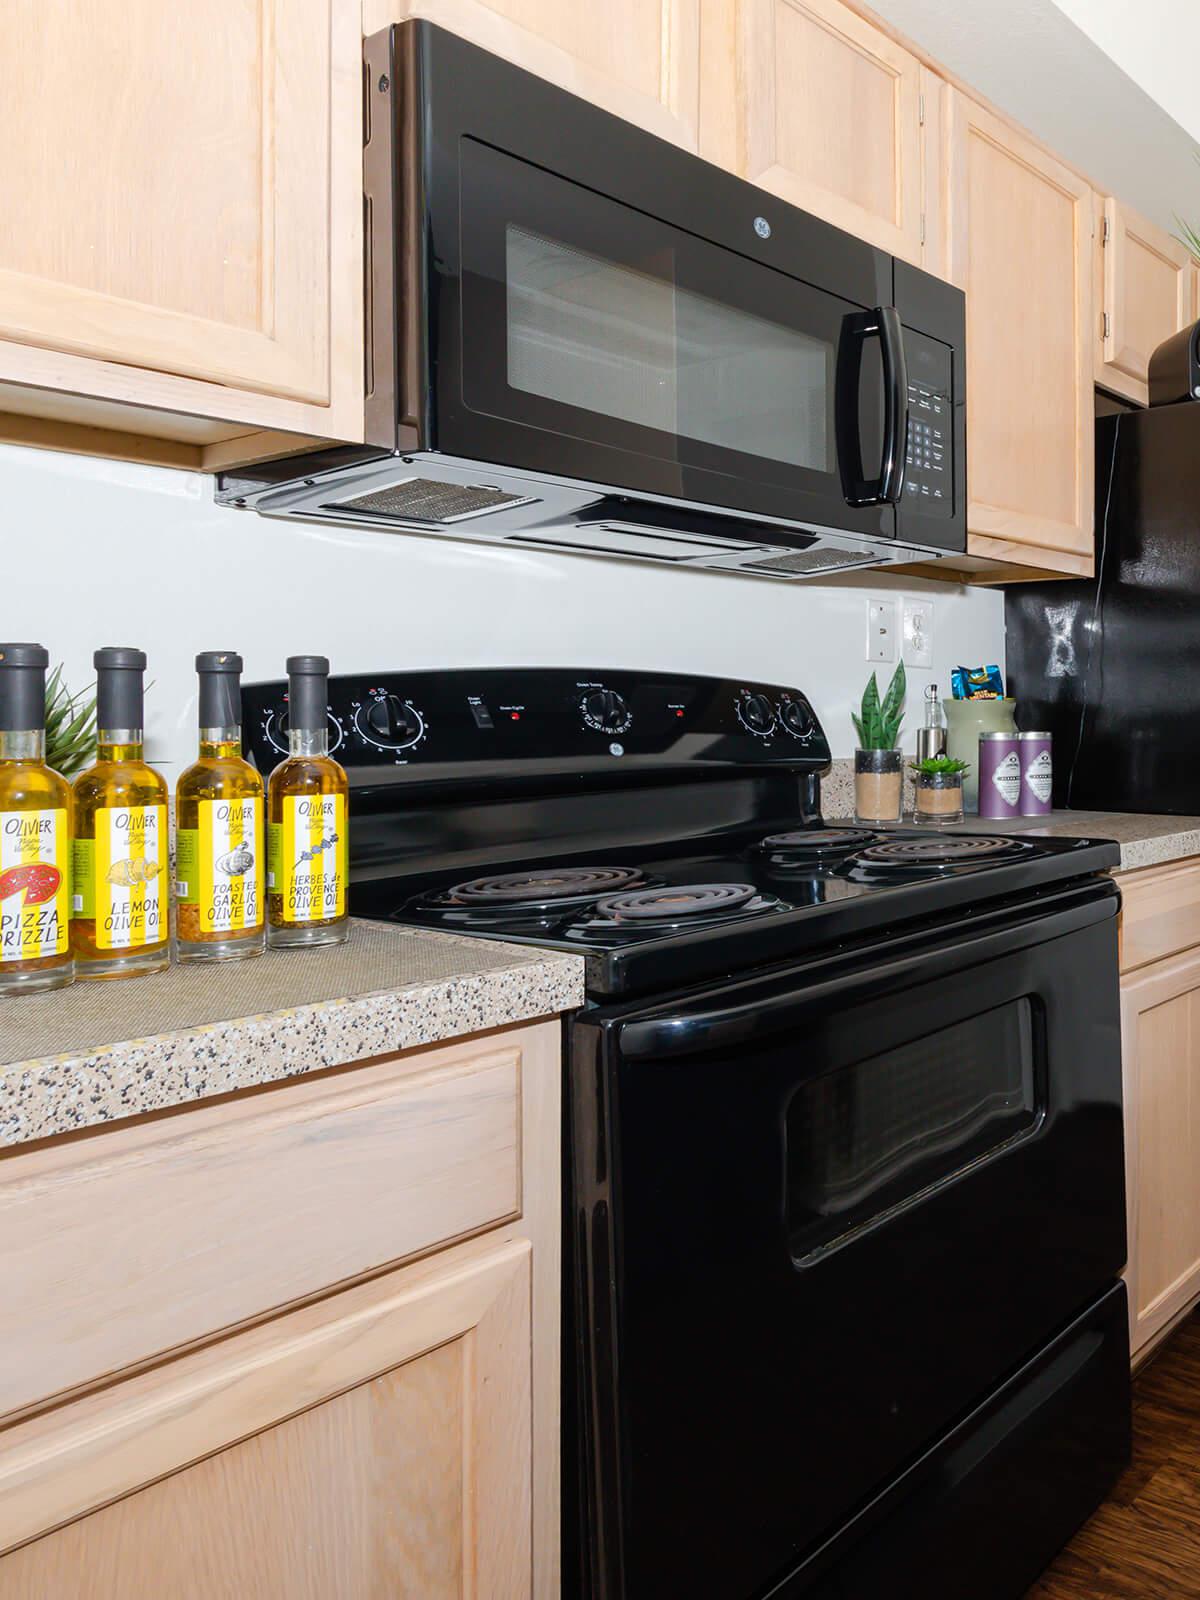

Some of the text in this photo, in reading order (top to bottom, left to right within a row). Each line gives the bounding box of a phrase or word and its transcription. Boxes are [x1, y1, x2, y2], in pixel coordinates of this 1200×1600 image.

[216, 805, 253, 823] OLIVIER
[298, 800, 334, 817] OLIVIER
[5, 817, 52, 837] OLIVIER
[115, 813, 156, 831] OLIVIER
[213, 880, 259, 894] TOASTED
[290, 872, 328, 886] HERBES
[289, 883, 340, 897] PROVENCE
[110, 899, 160, 916] LEMON
[213, 891, 256, 908] GARLIC
[288, 893, 342, 909] OLIVE OIL
[1, 909, 59, 930] PIZZA
[207, 903, 260, 921] OLIVE OIL
[104, 912, 164, 931] OLIVE OIL
